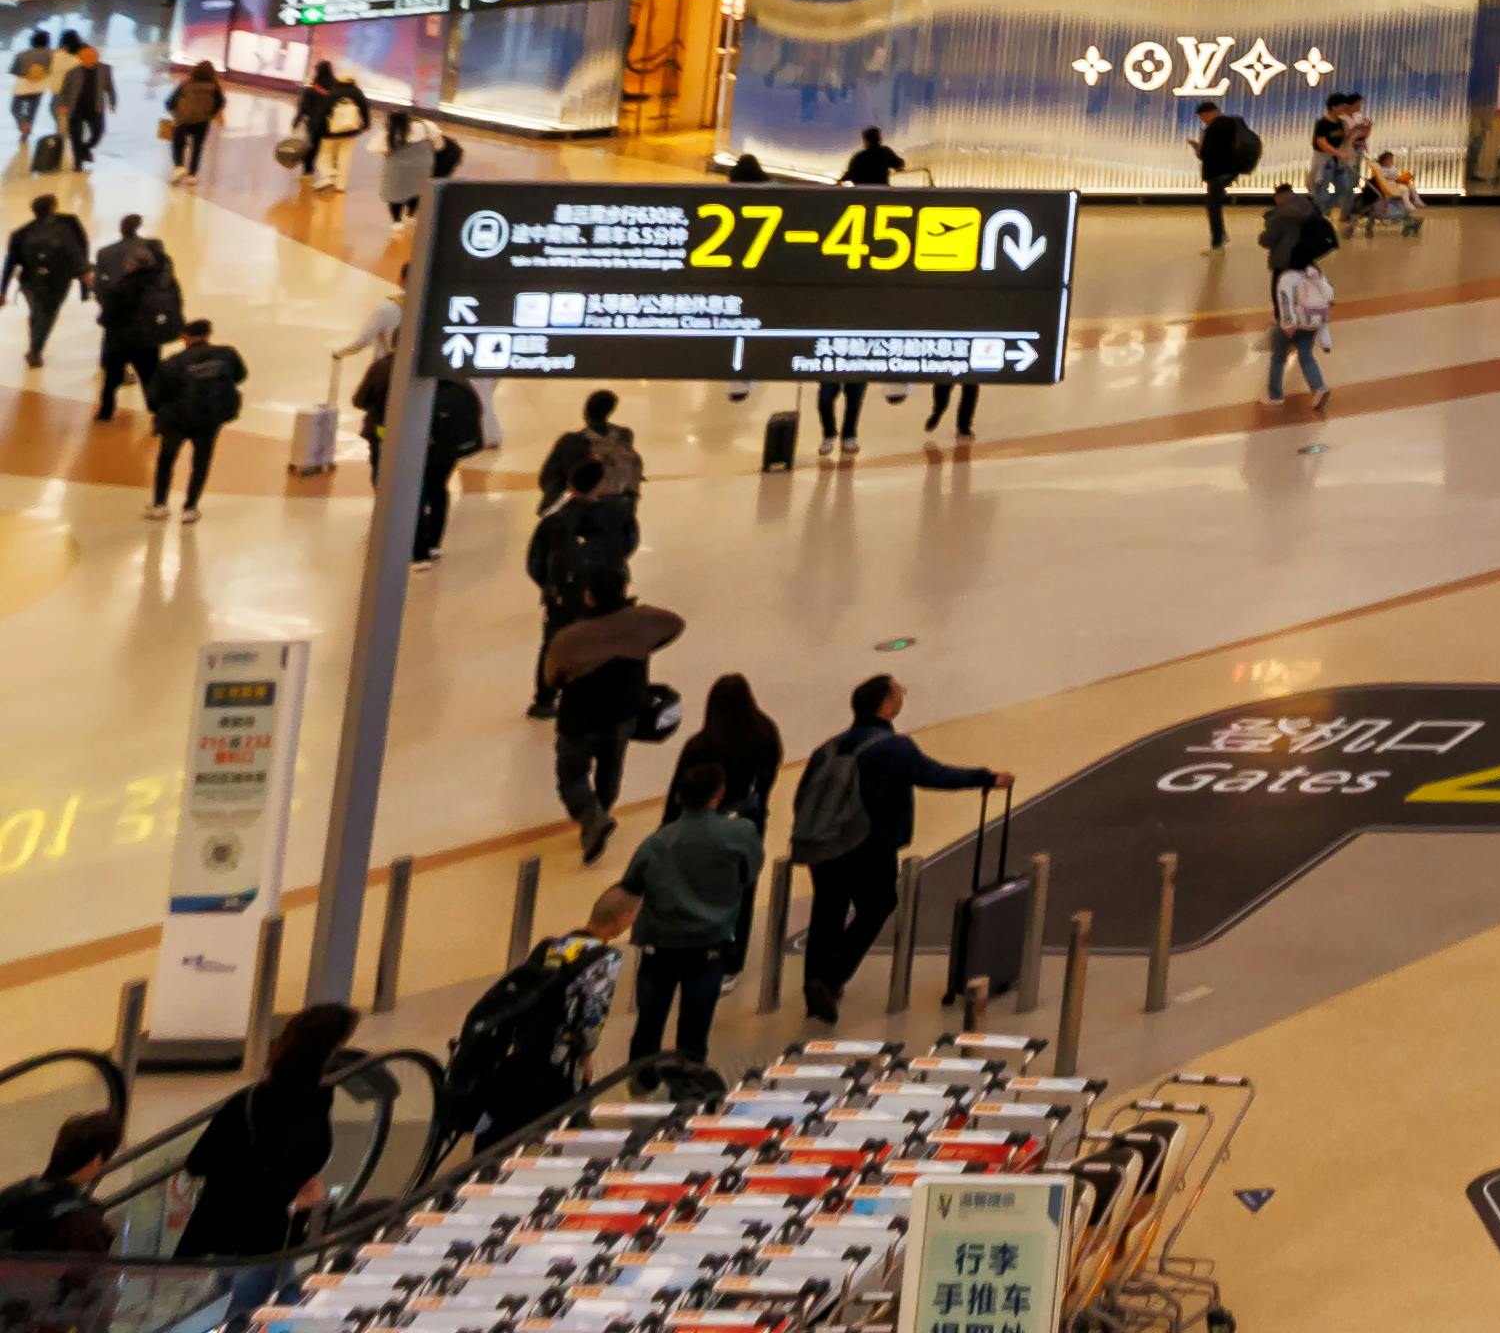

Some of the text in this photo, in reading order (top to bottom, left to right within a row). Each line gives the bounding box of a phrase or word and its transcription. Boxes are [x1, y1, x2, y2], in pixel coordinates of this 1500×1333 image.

[1172, 35, 1236, 97] LV
[690, 203, 914, 270] 27-45
[627, 315, 680, 330] Business
[680, 316, 712, 330] Class
[712, 317, 761, 331] Lounge
[791, 356, 823, 372] First
[836, 358, 888, 373] Business
[888, 359, 920, 373] Class
[921, 359, 969, 376] Lounge
[1186, 715, 1487, 756] 登机口
[1154, 762, 1391, 796] Gates
[955, 1242, 1020, 1277] 行李
[932, 1281, 1033, 1317] 手推车
